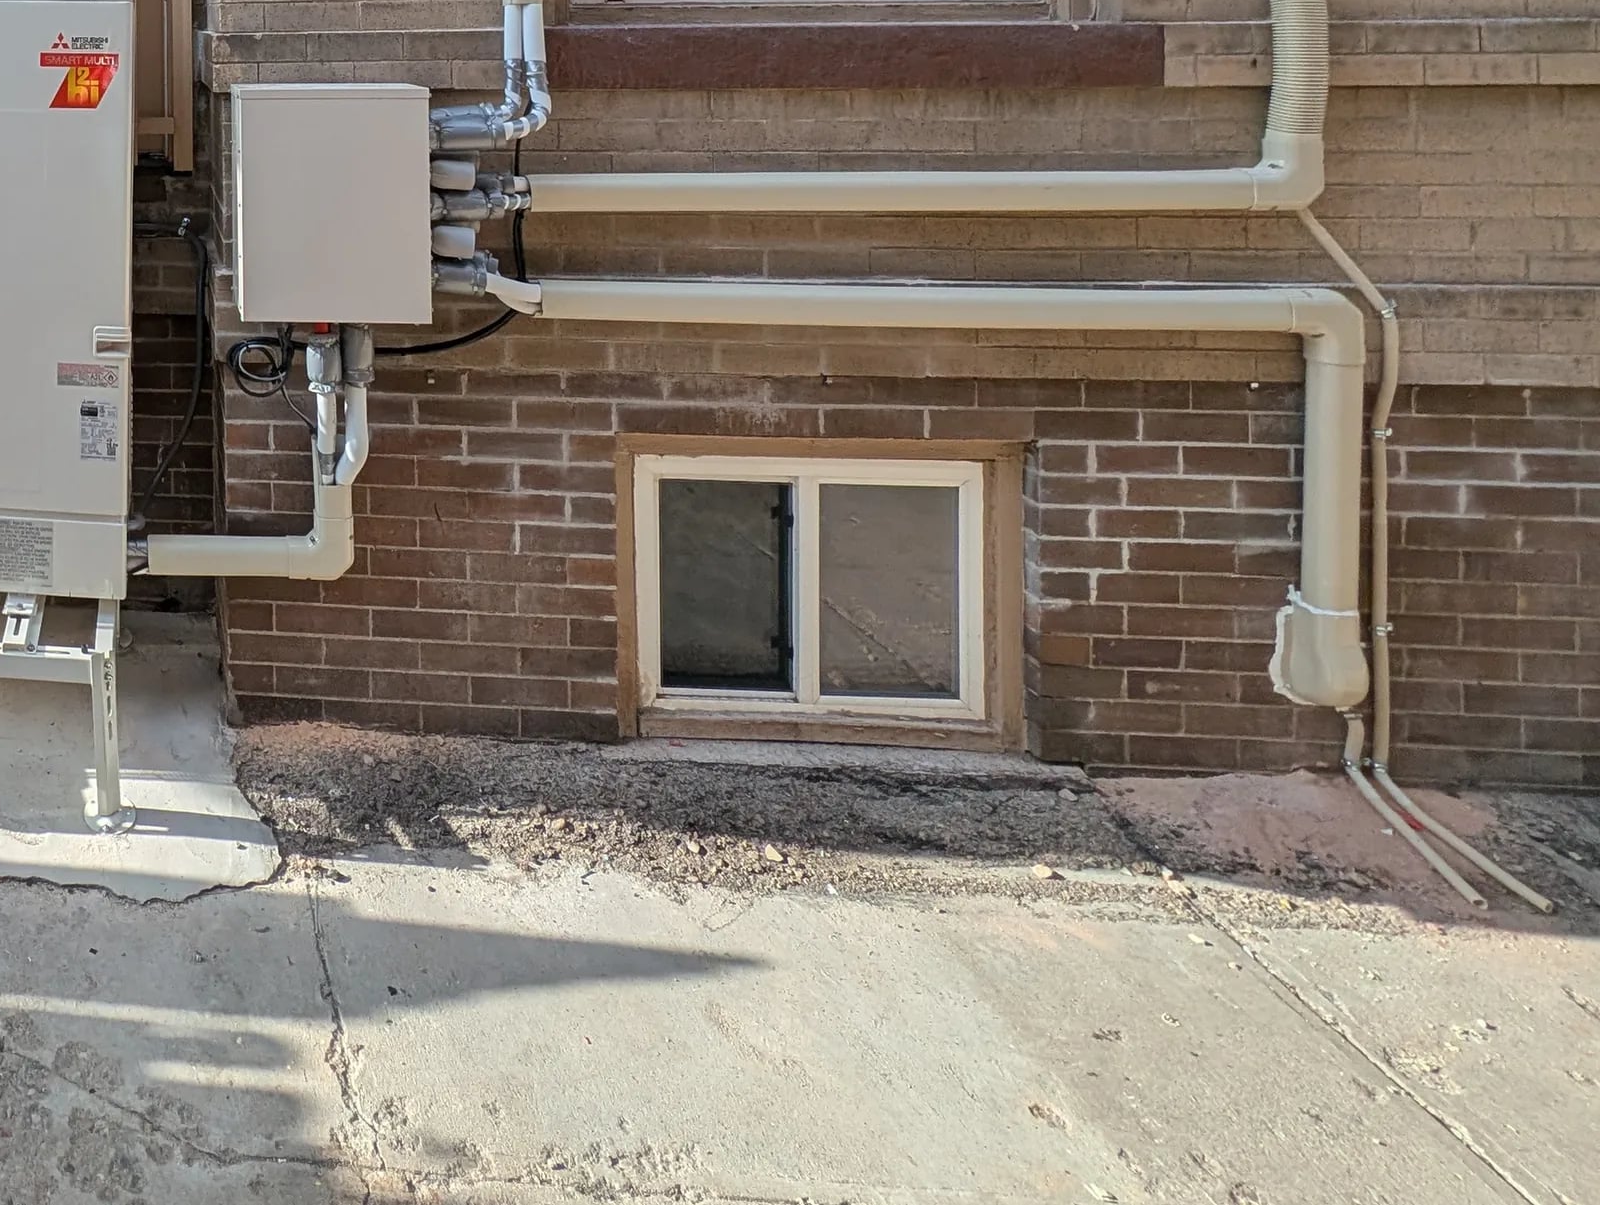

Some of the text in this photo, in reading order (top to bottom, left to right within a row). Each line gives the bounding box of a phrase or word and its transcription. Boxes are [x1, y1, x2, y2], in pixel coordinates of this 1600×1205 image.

[71, 36, 109, 44] MITSUBISHI
[44, 55, 115, 66] SMART MULTI
